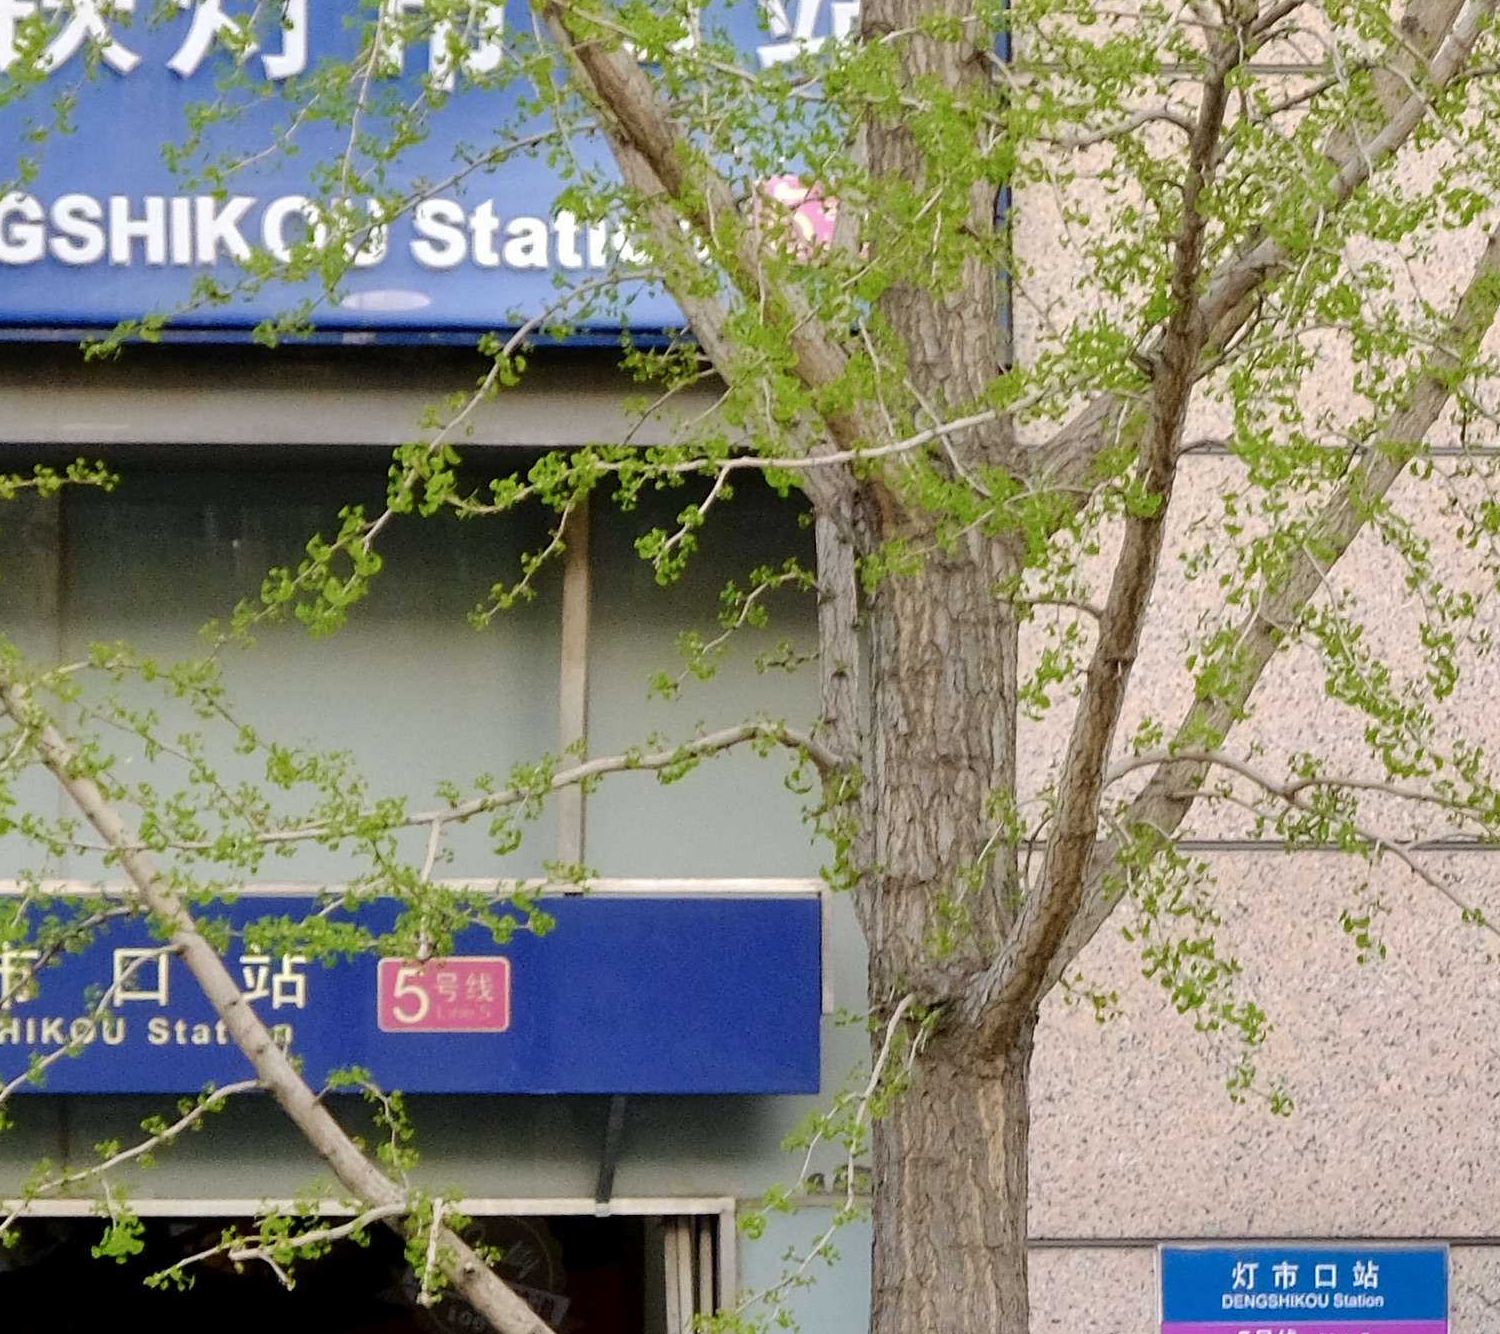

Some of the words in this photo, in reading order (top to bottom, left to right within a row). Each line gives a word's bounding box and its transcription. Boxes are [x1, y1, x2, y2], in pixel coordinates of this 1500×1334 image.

[410, 199, 705, 269] Stati
[393, 967, 494, 1024] 5号线
[148, 1017, 293, 1046] Statn
[1231, 1259, 1380, 1290] 灯市口站
[1221, 1293, 1329, 1310] DENGSHIKOU
[1333, 1292, 1385, 1309] Station
